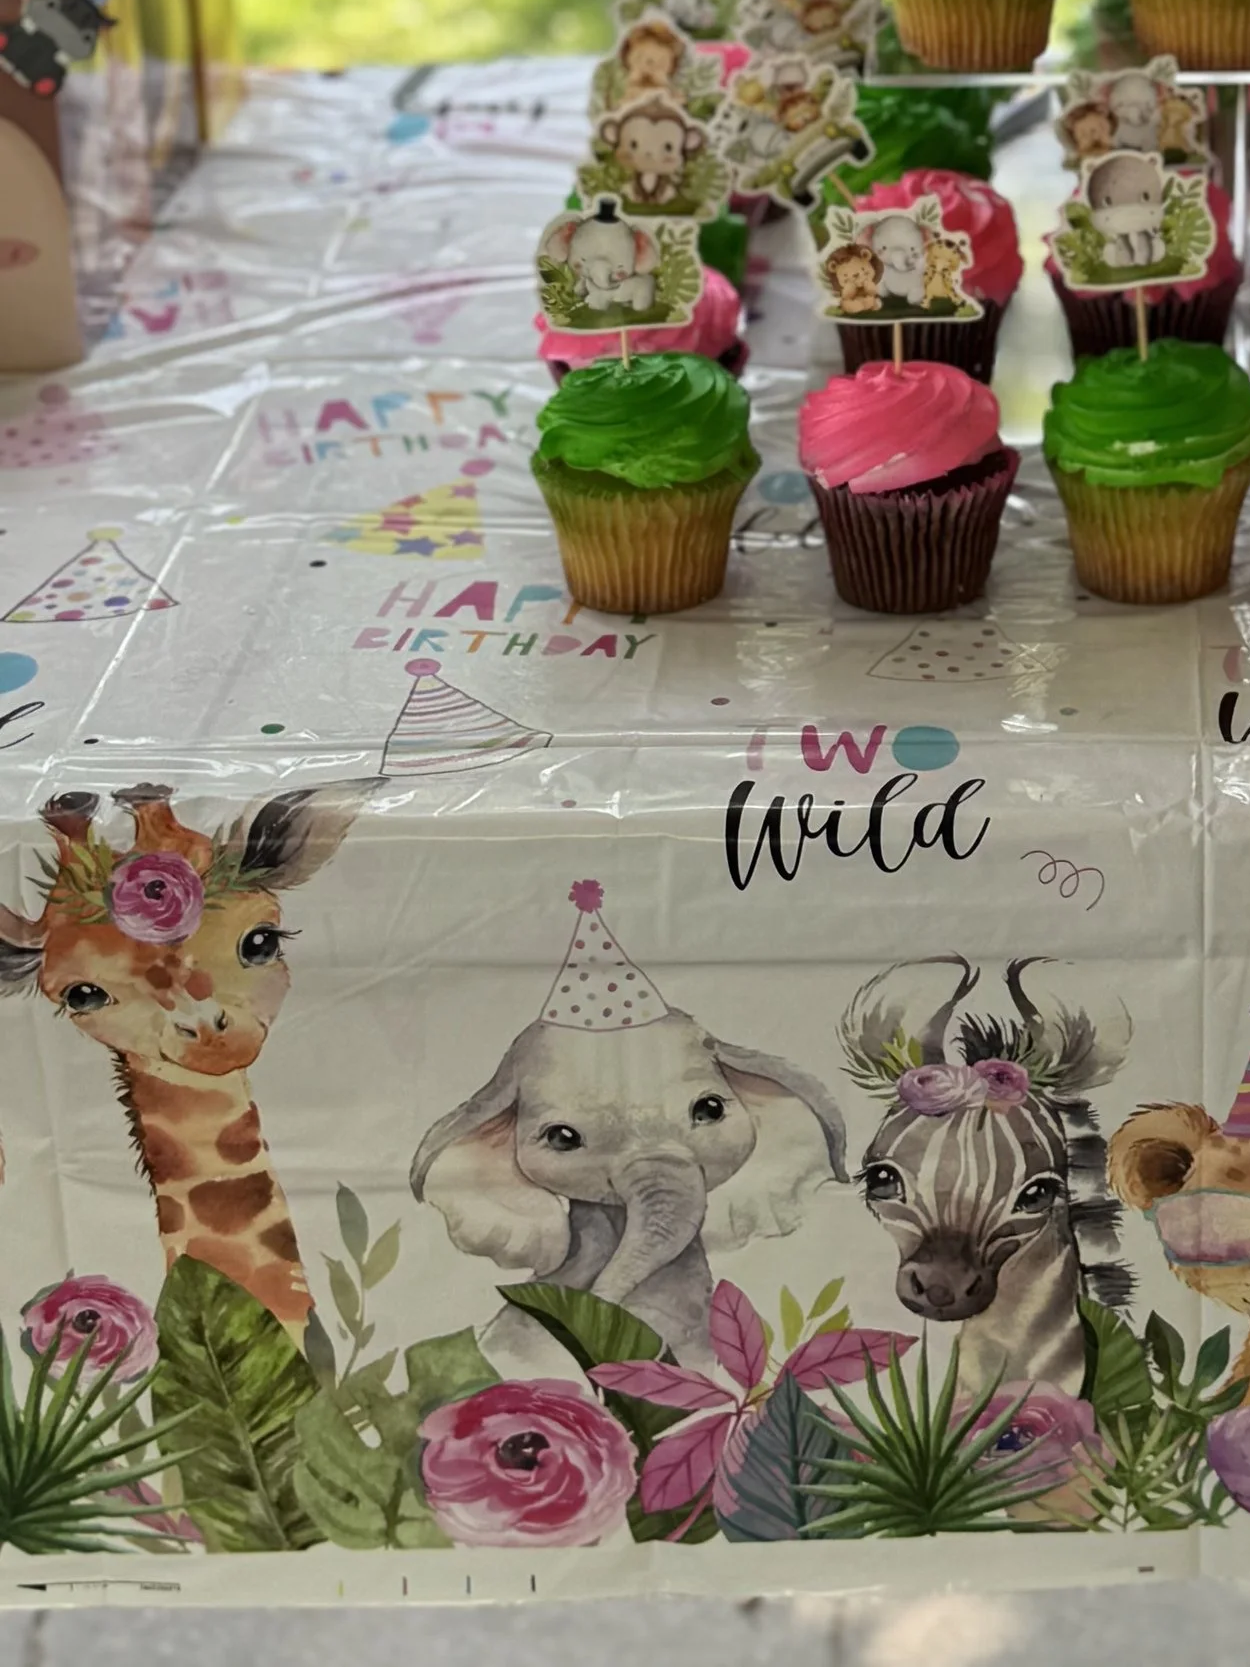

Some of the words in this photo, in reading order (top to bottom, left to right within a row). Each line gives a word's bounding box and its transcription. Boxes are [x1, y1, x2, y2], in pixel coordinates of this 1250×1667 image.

[376, 580, 648, 625] HAP
[352, 627, 658, 660] BIRTHDAY
[725, 772, 991, 891] Wild
